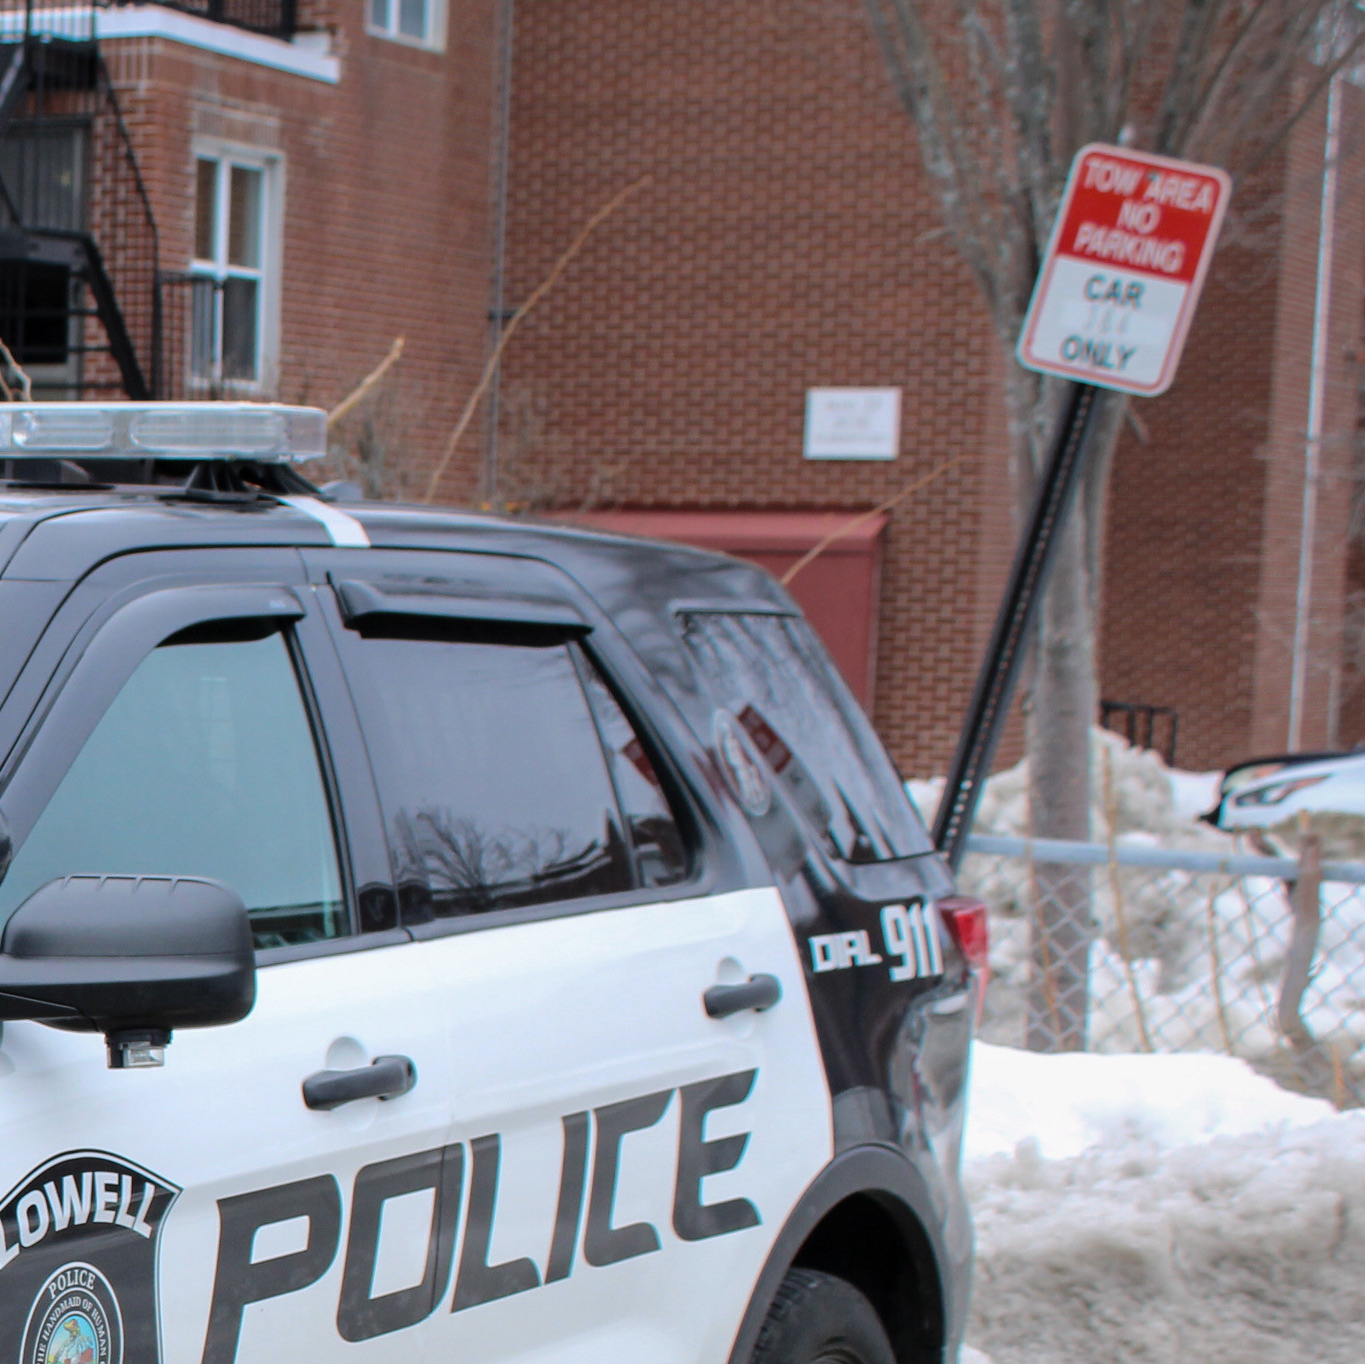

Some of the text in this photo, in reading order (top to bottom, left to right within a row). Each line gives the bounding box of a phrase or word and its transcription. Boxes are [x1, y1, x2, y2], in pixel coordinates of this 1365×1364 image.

[1083, 159, 1215, 213] TOW AREA
[1116, 199, 1161, 235] NO
[1073, 222, 1186, 274] PARKING
[1083, 274, 1146, 309] CAR
[1060, 334, 1138, 371] ONLY
[808, 902, 944, 982] DIAL 911
[48, 1268, 96, 1300] POLICE
[42, 1296, 82, 1341] HANDMAID
[82, 1298, 93, 1312] OF
[90, 1308, 107, 1357] HUMAN
